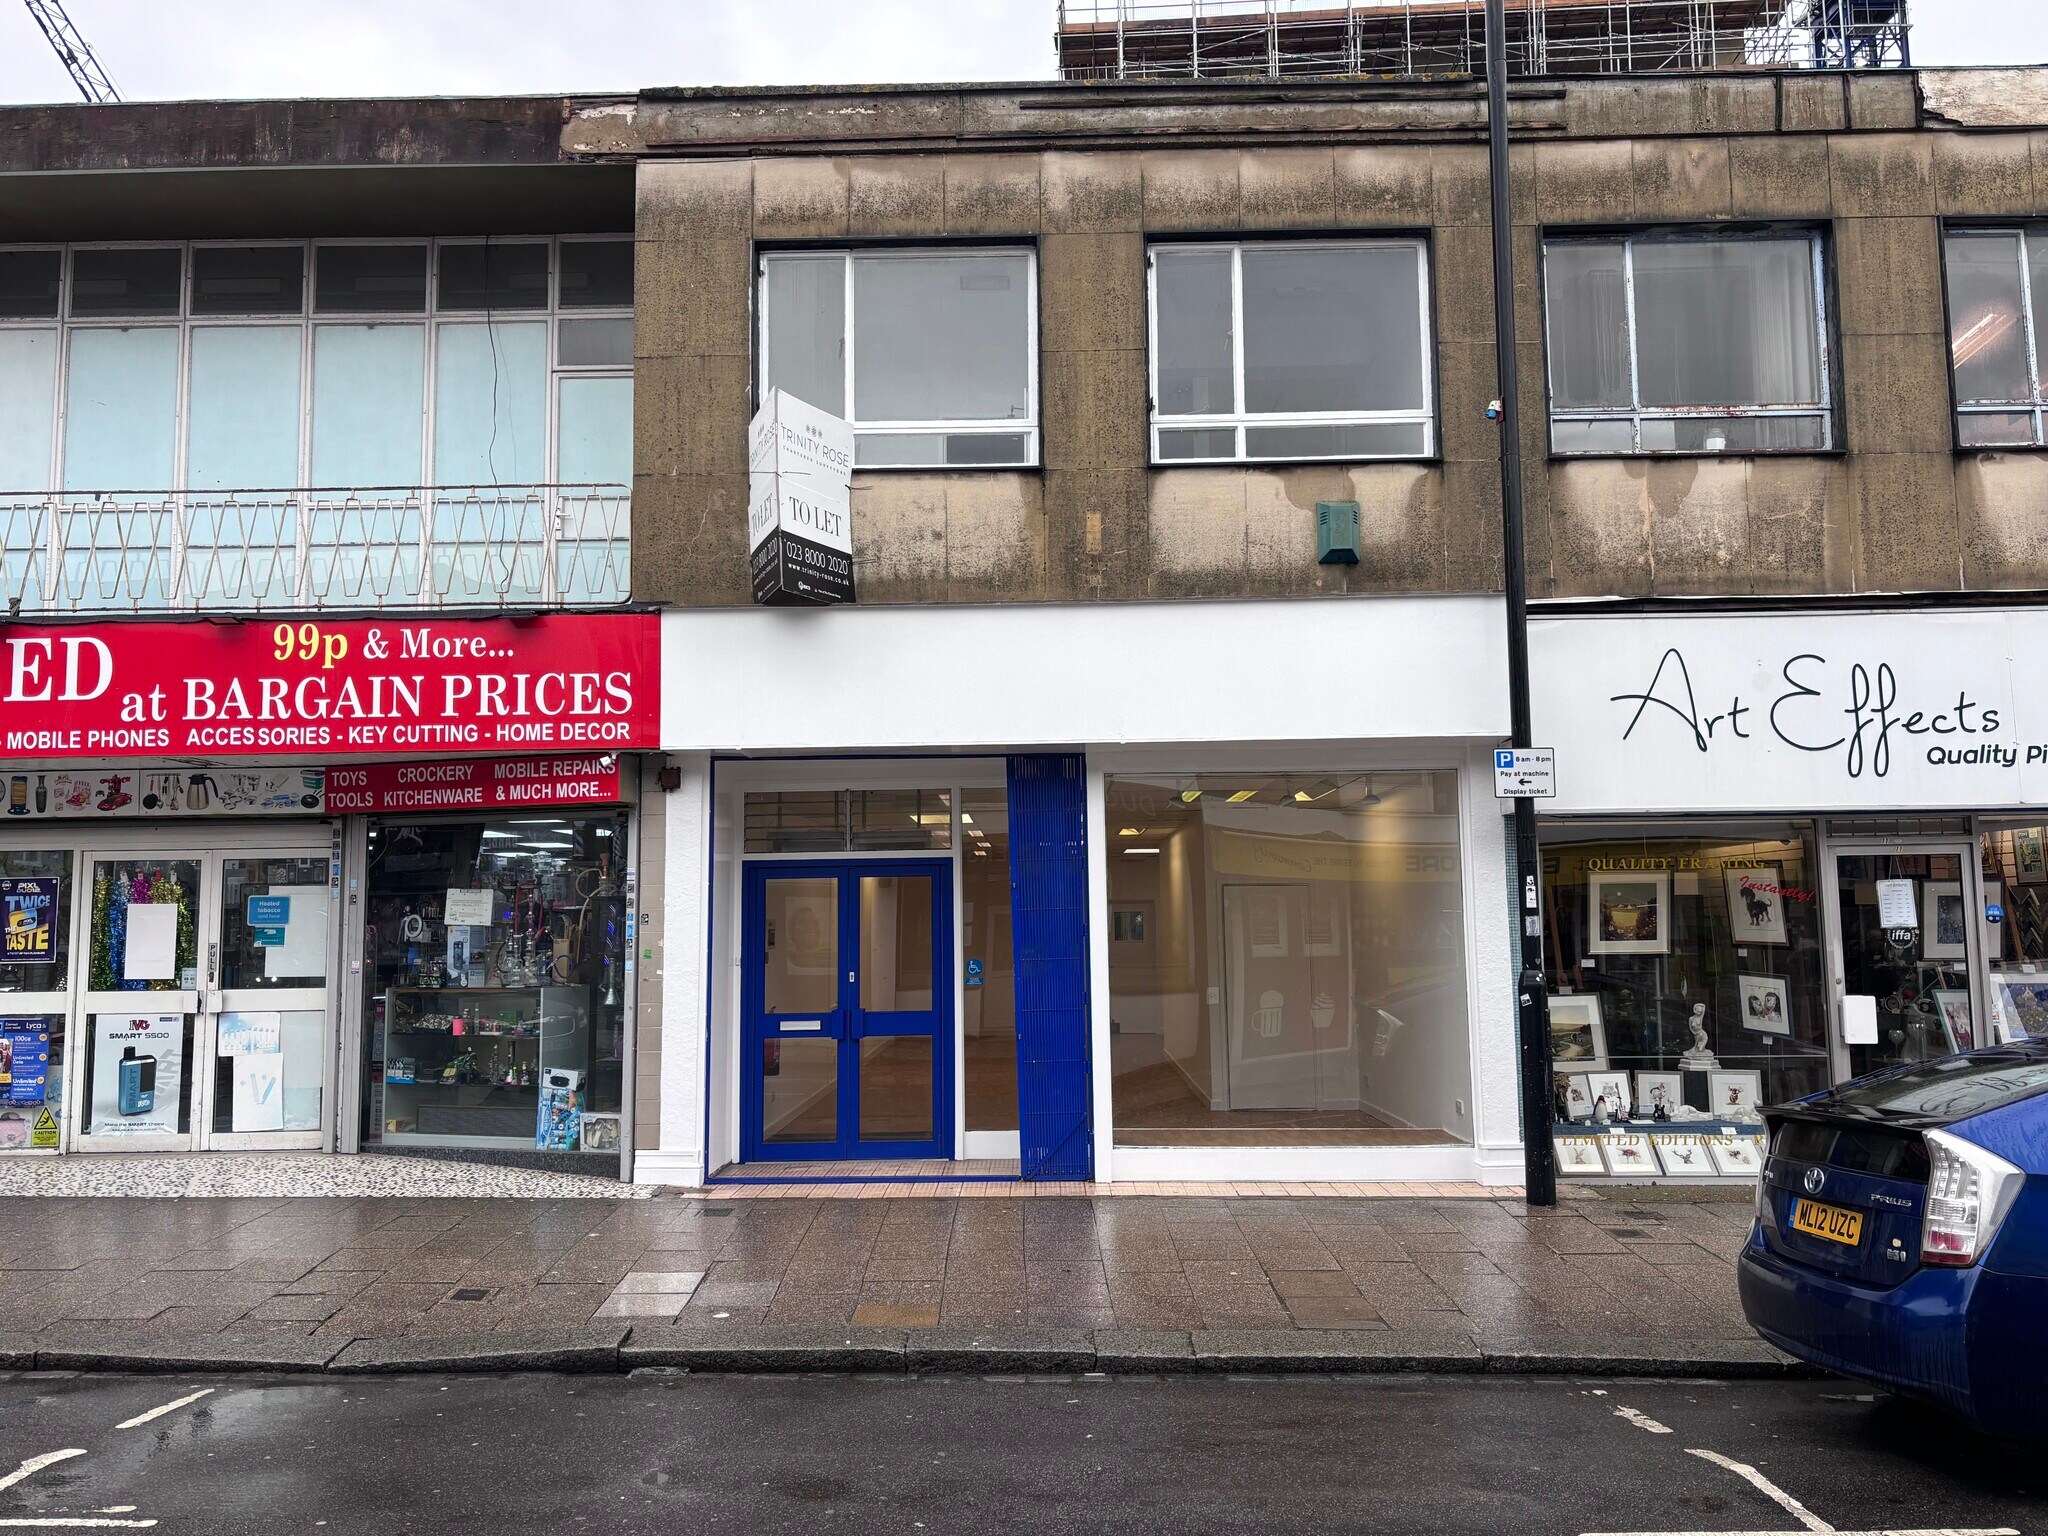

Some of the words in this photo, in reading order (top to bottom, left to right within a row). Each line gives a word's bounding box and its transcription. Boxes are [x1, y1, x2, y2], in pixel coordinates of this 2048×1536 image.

[781, 425, 820, 454] TRINITY
[823, 445, 849, 468] ROSE
[752, 509, 760, 536] TO
[760, 493, 773, 527] LET
[789, 496, 811, 525] TO
[814, 506, 842, 537] LET
[786, 541, 803, 561] 023
[805, 547, 826, 569] 8000
[828, 556, 849, 575] 2020
[788, 563, 849, 586] www.trinity-rose.co.uk
[273, 622, 348, 669] 99p
[363, 628, 389, 660] &
[400, 628, 514, 659] More...
[2, 636, 113, 702] ED
[120, 684, 167, 722] at
[182, 675, 424, 720] BARGAIN
[440, 671, 633, 718] PRICES
[1610, 647, 1750, 753] Art
[1770, 653, 2000, 778] Effects
[7, 731, 81, 750] MOBILE
[88, 728, 169, 748] PHONES
[186, 726, 330, 746] ACCESSORIES
[349, 725, 388, 744] KEY
[392, 723, 478, 743] CUTTING
[496, 722, 554, 742] HOME
[560, 721, 631, 741] DECOR
[1926, 744, 2017, 768] Quality
[2026, 744, 2048, 764] Pi
[331, 770, 367, 787] TOYS
[397, 765, 474, 784] CROCKERY
[494, 761, 549, 779] MOBILE
[329, 792, 374, 808] TOOLS
[383, 787, 483, 807] KITCHENWARE
[495, 785, 506, 800] &
[509, 783, 552, 800] MUCH
[556, 781, 612, 799] MORE...
[1588, 857, 1670, 872] QUALITY
[1739, 875, 1817, 903] Instantly!
[5, 895, 51, 912] TWICE
[6, 923, 49, 951] TASTE
[1891, 929, 1911, 940] iffa
[26, 1022, 42, 1030] Lyca
[129, 1068, 137, 1109] SMART
[1562, 1134, 1640, 1147] LIMITED
[1650, 1133, 1733, 1147] EDITIONS
[1870, 1193, 1912, 1207] PRIUS
[1798, 1202, 1828, 1232] ML12
[1828, 1210, 1858, 1240] UZC
